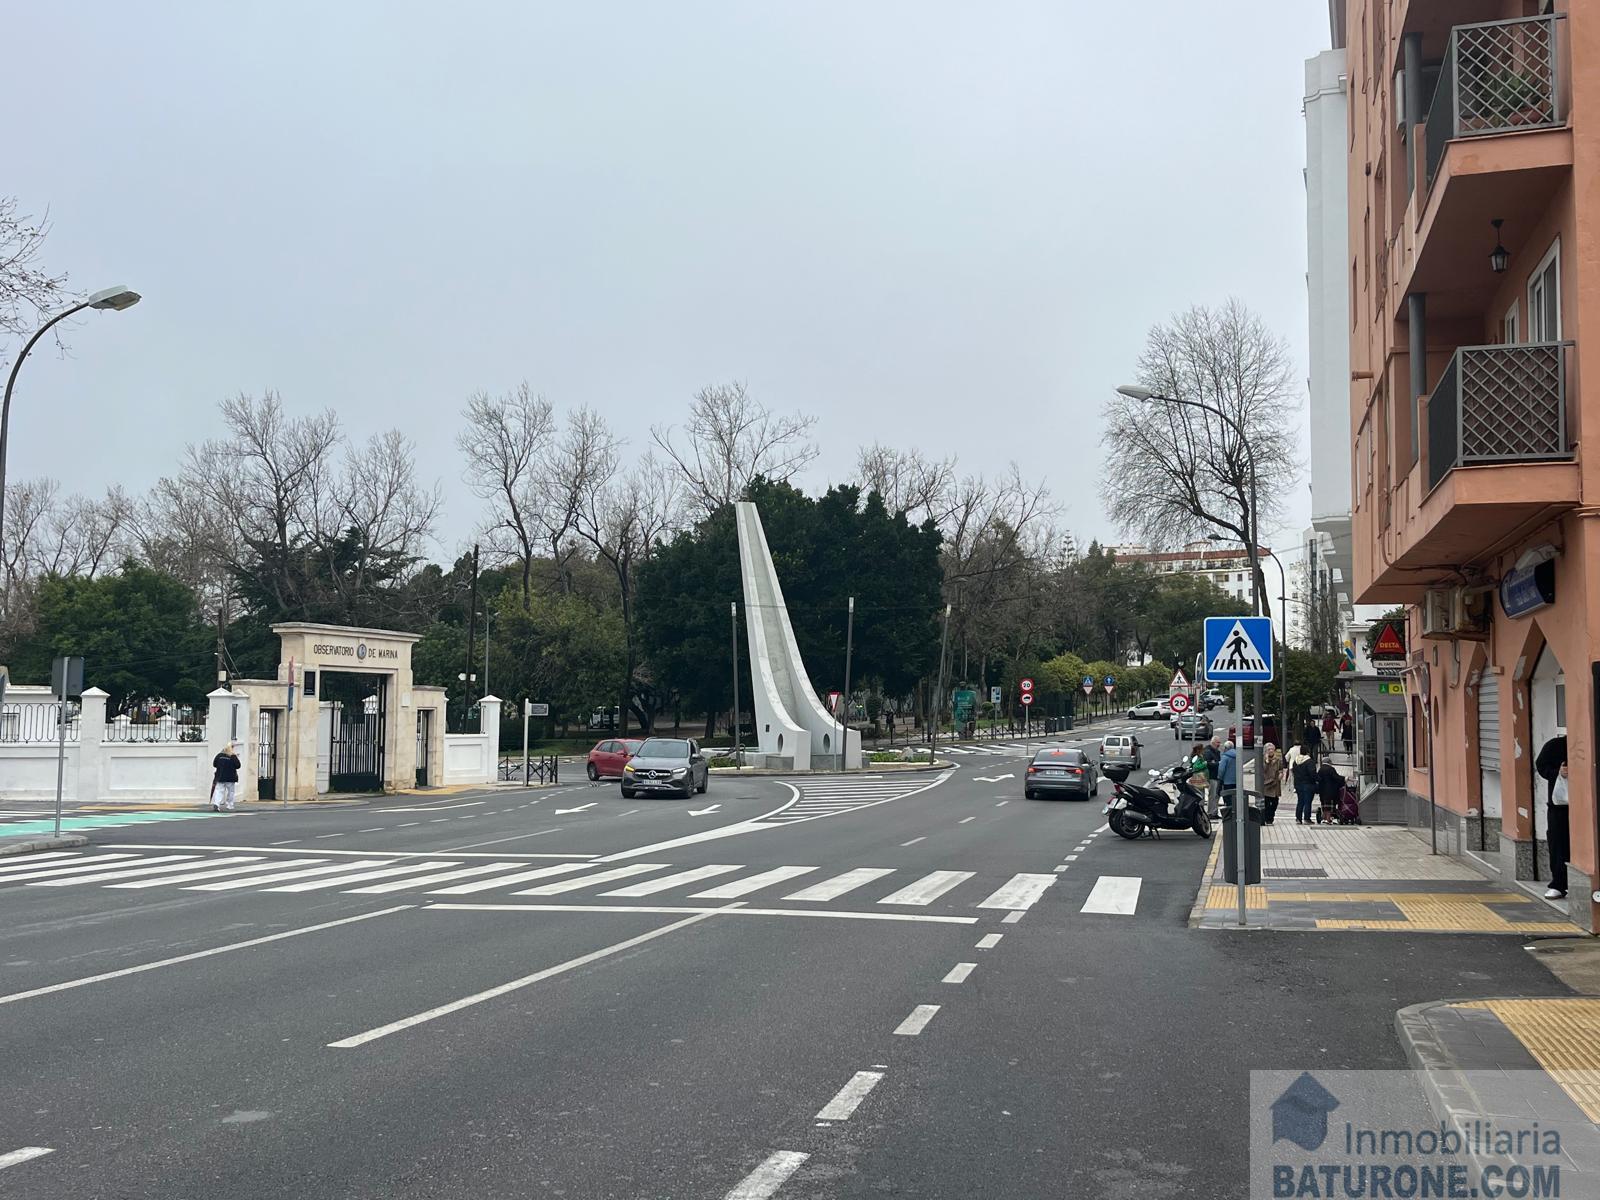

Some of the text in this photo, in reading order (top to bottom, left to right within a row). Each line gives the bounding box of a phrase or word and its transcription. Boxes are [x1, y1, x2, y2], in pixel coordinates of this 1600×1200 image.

[313, 644, 398, 660] OBSERVATORIO DE MARINA
